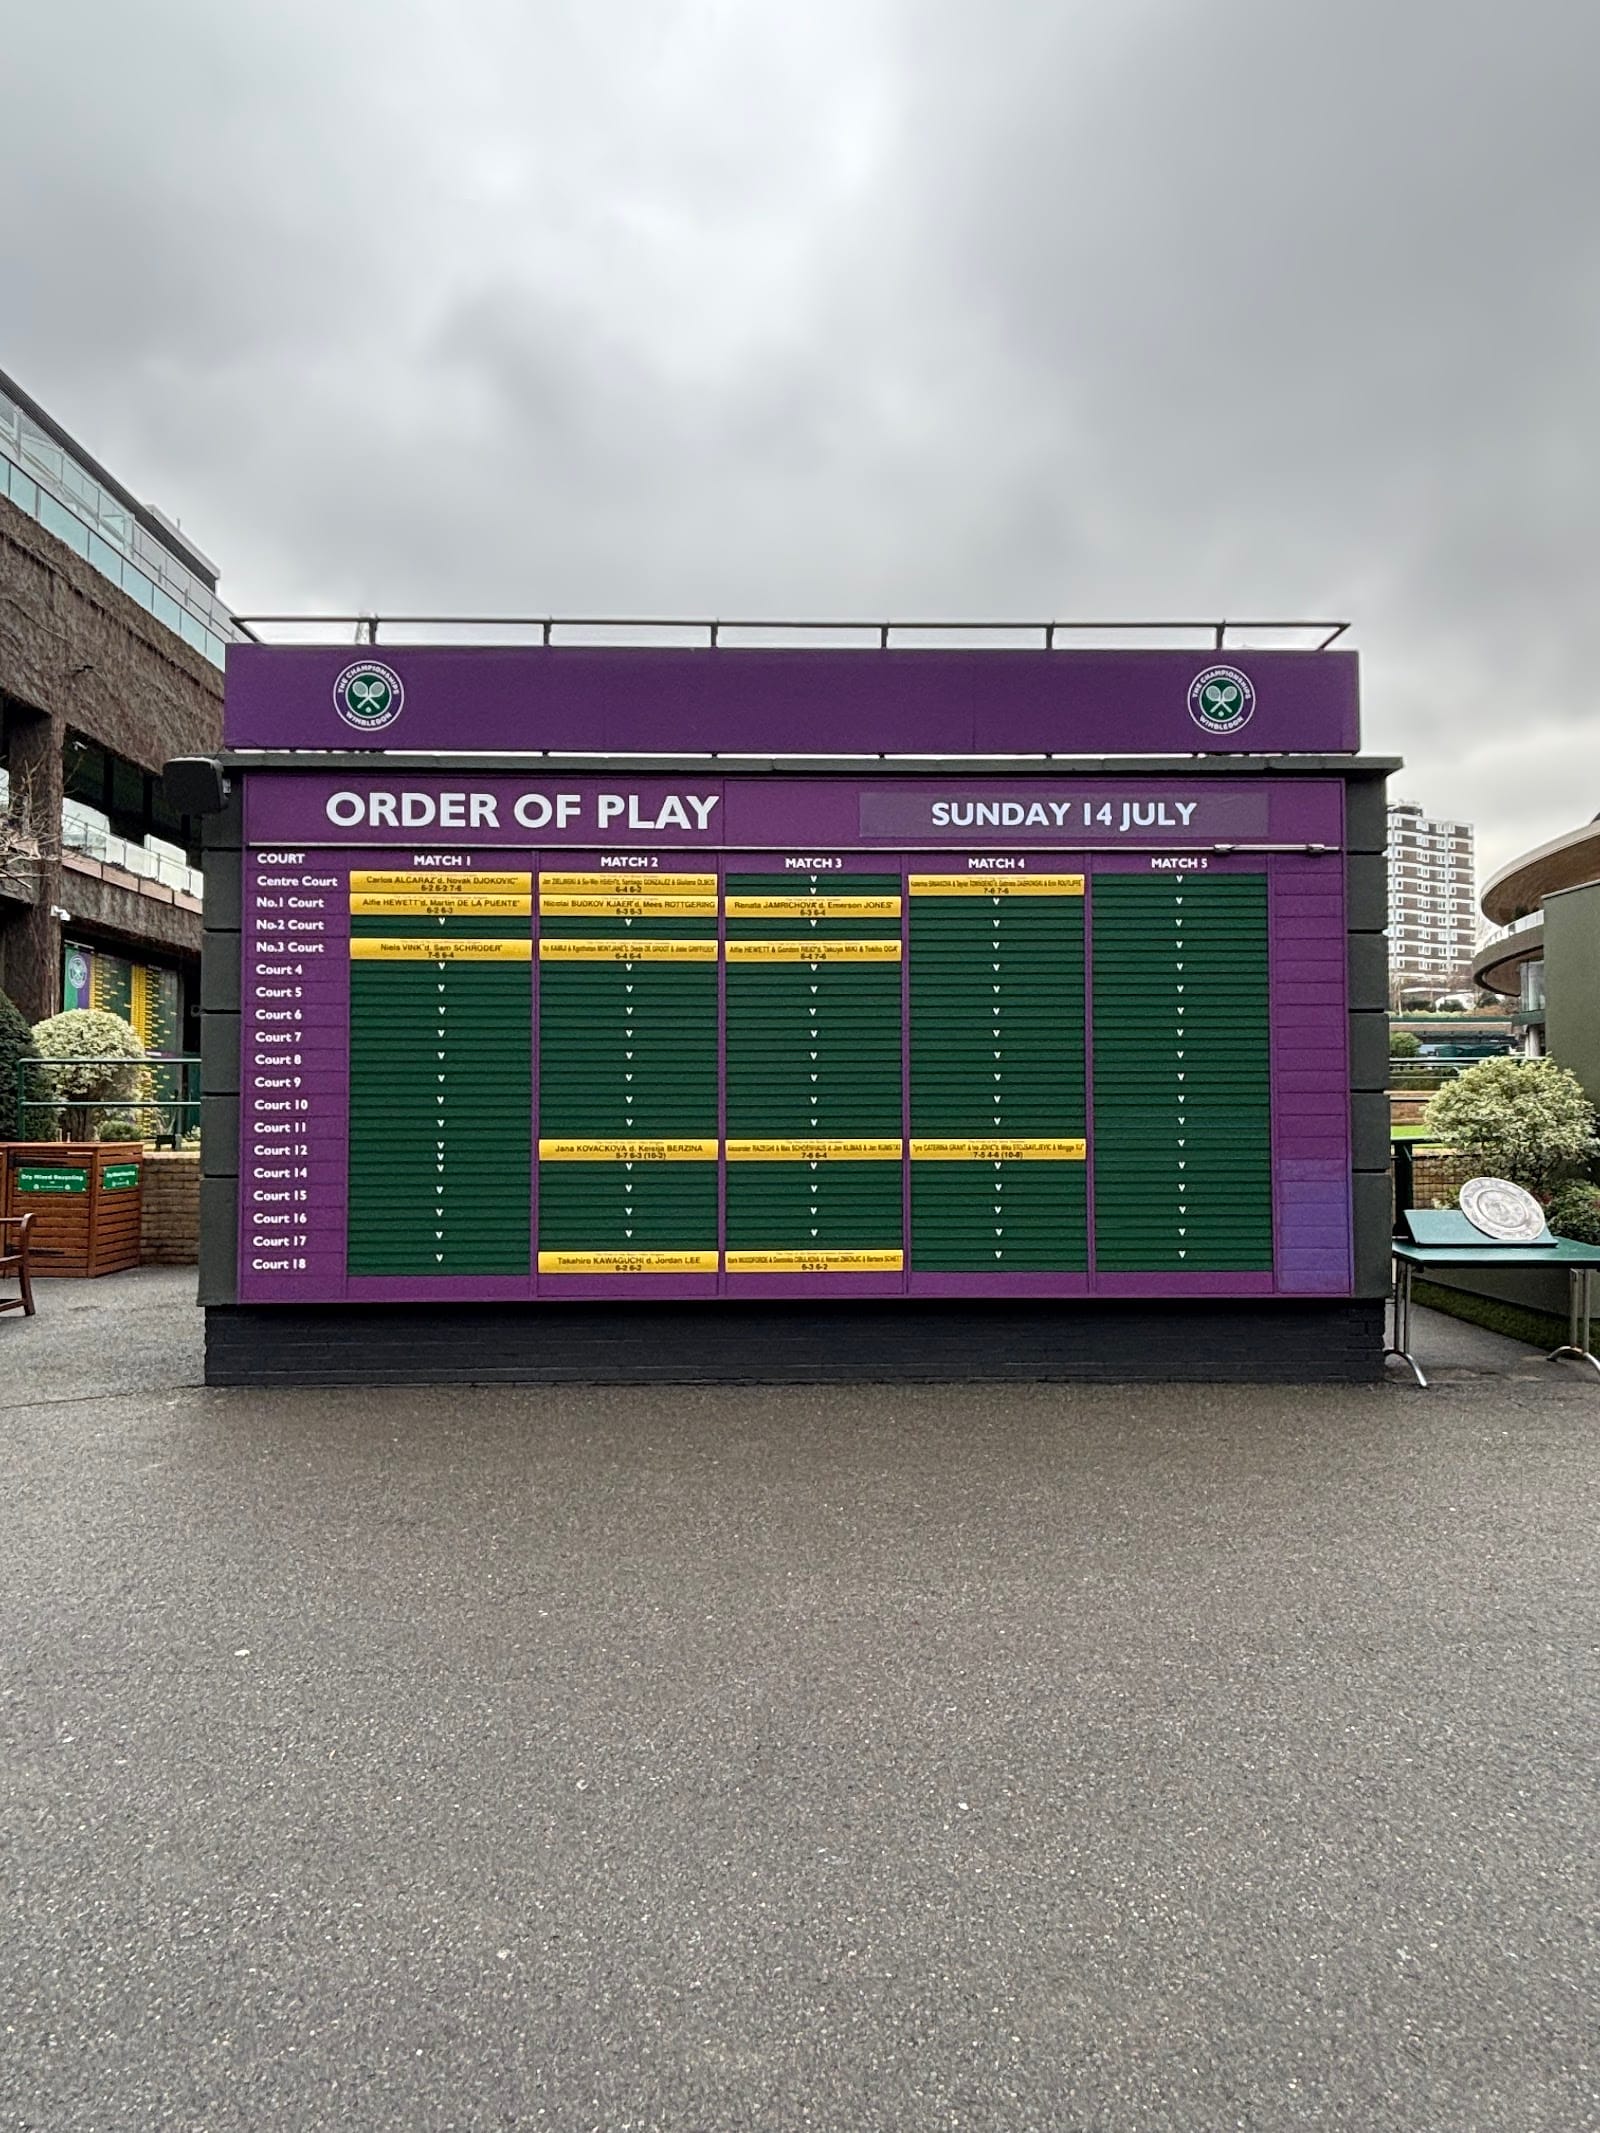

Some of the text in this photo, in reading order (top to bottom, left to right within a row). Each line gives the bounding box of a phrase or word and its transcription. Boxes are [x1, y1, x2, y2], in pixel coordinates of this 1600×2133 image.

[338, 664, 400, 694] THE CHAMPIONSHIPS
[1192, 670, 1252, 699] THE CHAMPIONSHIPS
[346, 711, 392, 726] WIMBLEDON
[1200, 715, 1244, 730] WIMBLEDON
[326, 791, 720, 830] ORDER OF PLAY
[931, 802, 1197, 832] SUNDAY 14 JULY
[257, 853, 305, 864] COURT
[414, 856, 471, 866] MATCH 1
[601, 857, 658, 867] MATCH 2
[786, 858, 842, 868] MATCH 3
[969, 859, 1025, 868] MATCH 4
[1152, 858, 1208, 868] MATCH 5
[257, 876, 338, 887] Centre Court
[288, 897, 324, 908] Court
[288, 920, 324, 930] Court
[288, 942, 324, 952] Court
[256, 964, 302, 974] Court 4
[256, 987, 302, 997] Court 5
[256, 1010, 302, 1020] Court 6
[256, 1032, 302, 1042] Court 7
[255, 1055, 302, 1065] Court 8
[255, 1077, 302, 1087] Court 9
[254, 1100, 308, 1110] Court 10
[254, 1122, 306, 1132] Court 11
[254, 1145, 308, 1155] Court 12
[254, 1168, 308, 1178] Court 14
[254, 1190, 307, 1200] Court 15
[254, 1213, 307, 1224] Court 16
[253, 1236, 306, 1246] Court 17
[252, 1258, 306, 1270] Court 18
